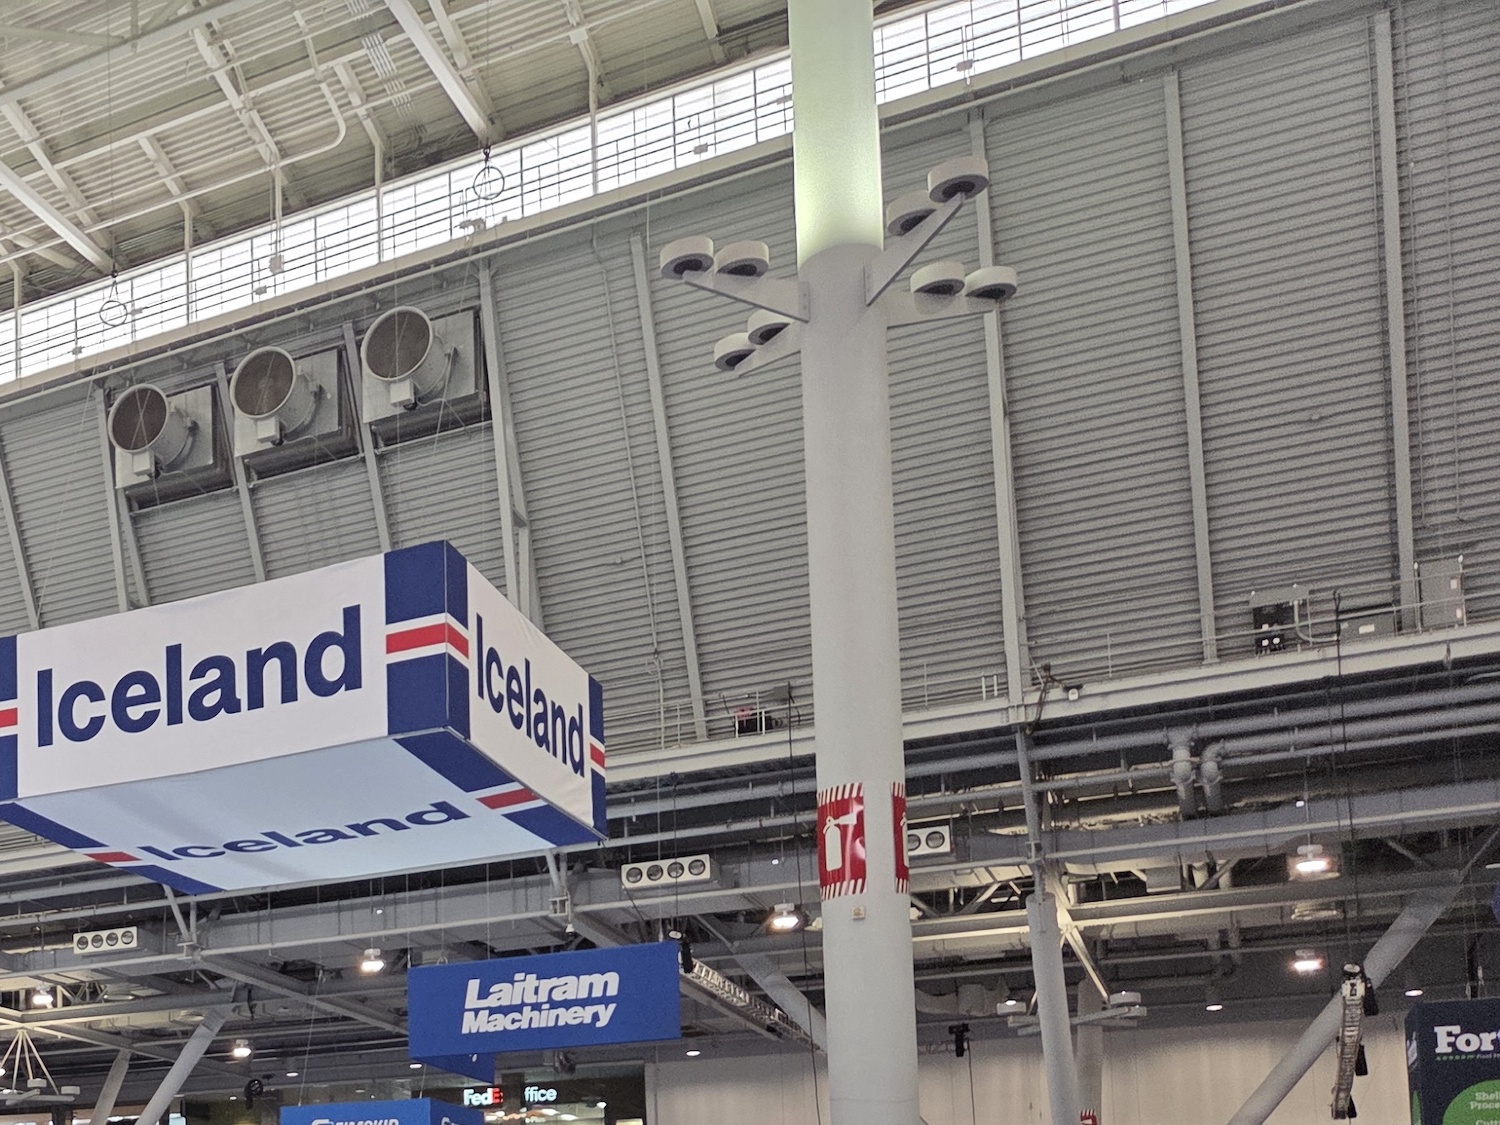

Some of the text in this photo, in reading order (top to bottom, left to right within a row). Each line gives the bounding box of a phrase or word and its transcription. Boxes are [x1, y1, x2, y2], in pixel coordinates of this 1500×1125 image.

[37, 604, 362, 747] Iceland
[476, 612, 586, 778] Iceland
[139, 800, 470, 860] Iceland
[464, 971, 619, 1009] Laitram
[461, 1001, 616, 1034] Machinery
[1433, 1025, 1500, 1053] For
[524, 1086, 557, 1102] ffice
